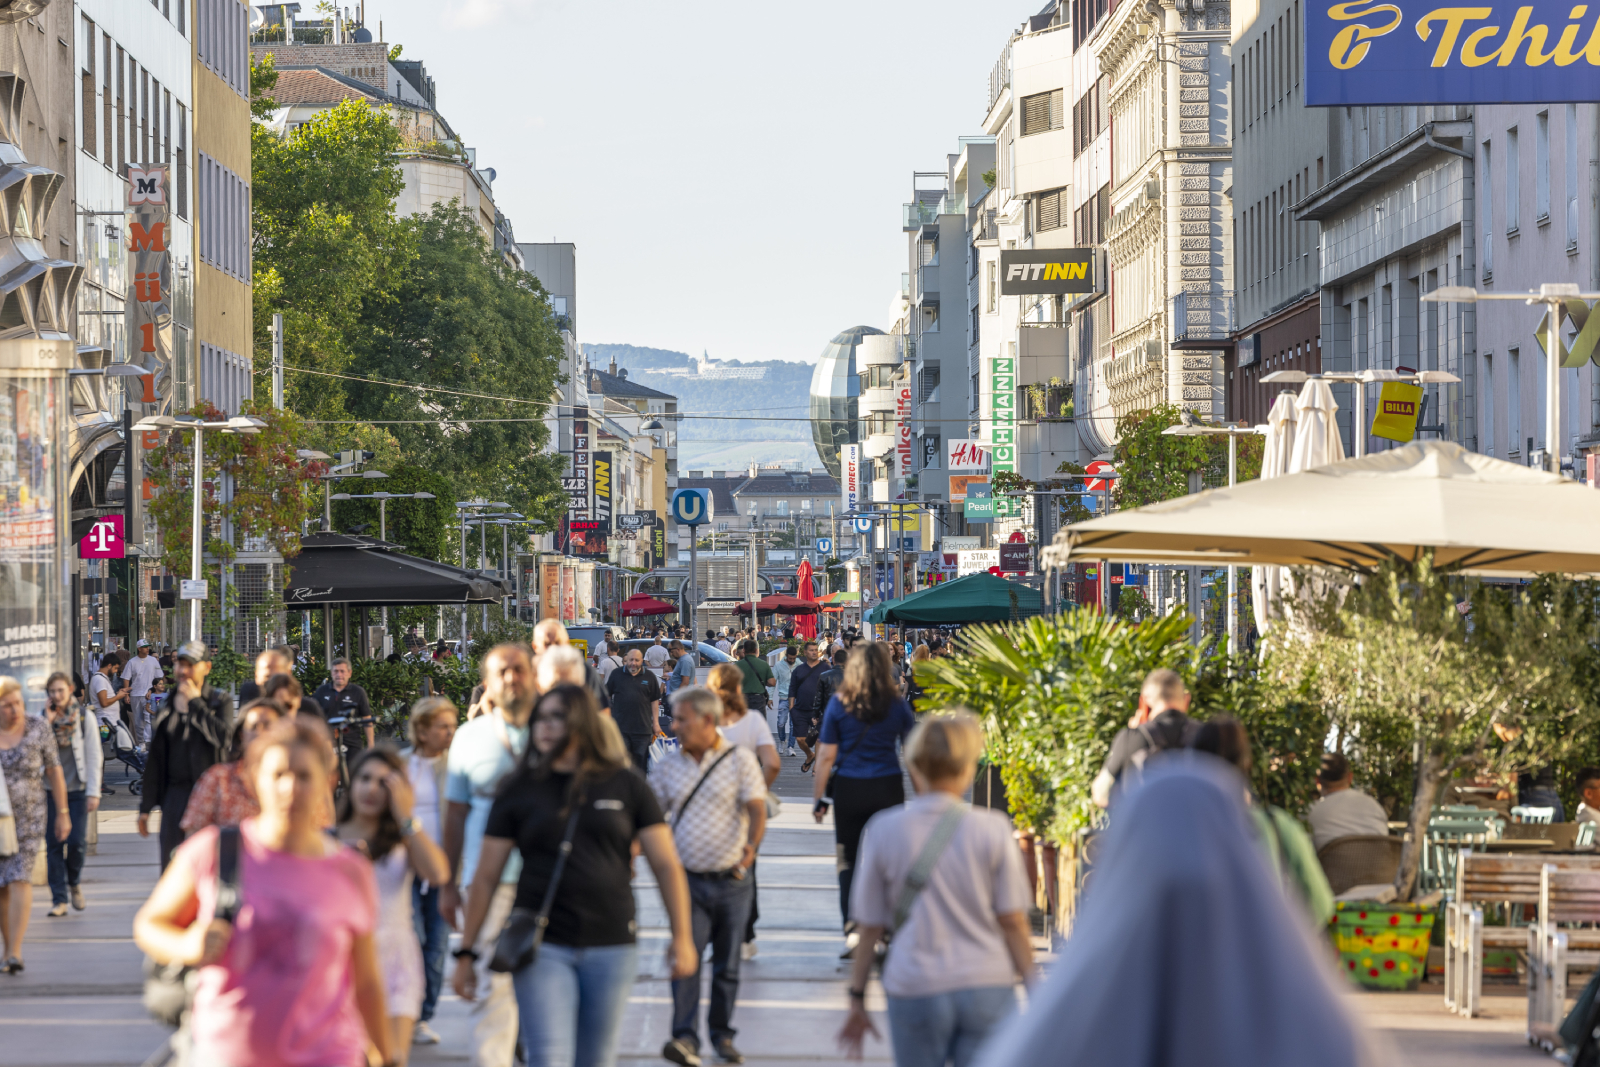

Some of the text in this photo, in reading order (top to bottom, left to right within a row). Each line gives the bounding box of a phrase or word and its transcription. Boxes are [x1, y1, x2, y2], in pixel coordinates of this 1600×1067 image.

[137, 178, 157, 194] M
[1006, 262, 1089, 281] FITINN
[128, 222, 166, 500] Müller
[1385, 402, 1413, 414] BILLA
[996, 359, 1009, 513] DCHMANN
[951, 443, 983, 466] H&M
[562, 479, 586, 490] LZE
[678, 497, 700, 521] U
[968, 502, 993, 511] Pearl
[858, 518, 872, 531] U
[90, 522, 115, 551] T
[654, 529, 663, 558] saloni
[819, 541, 829, 551] U
[943, 541, 980, 551] Fielmann
[962, 561, 997, 569] JUWELIER
